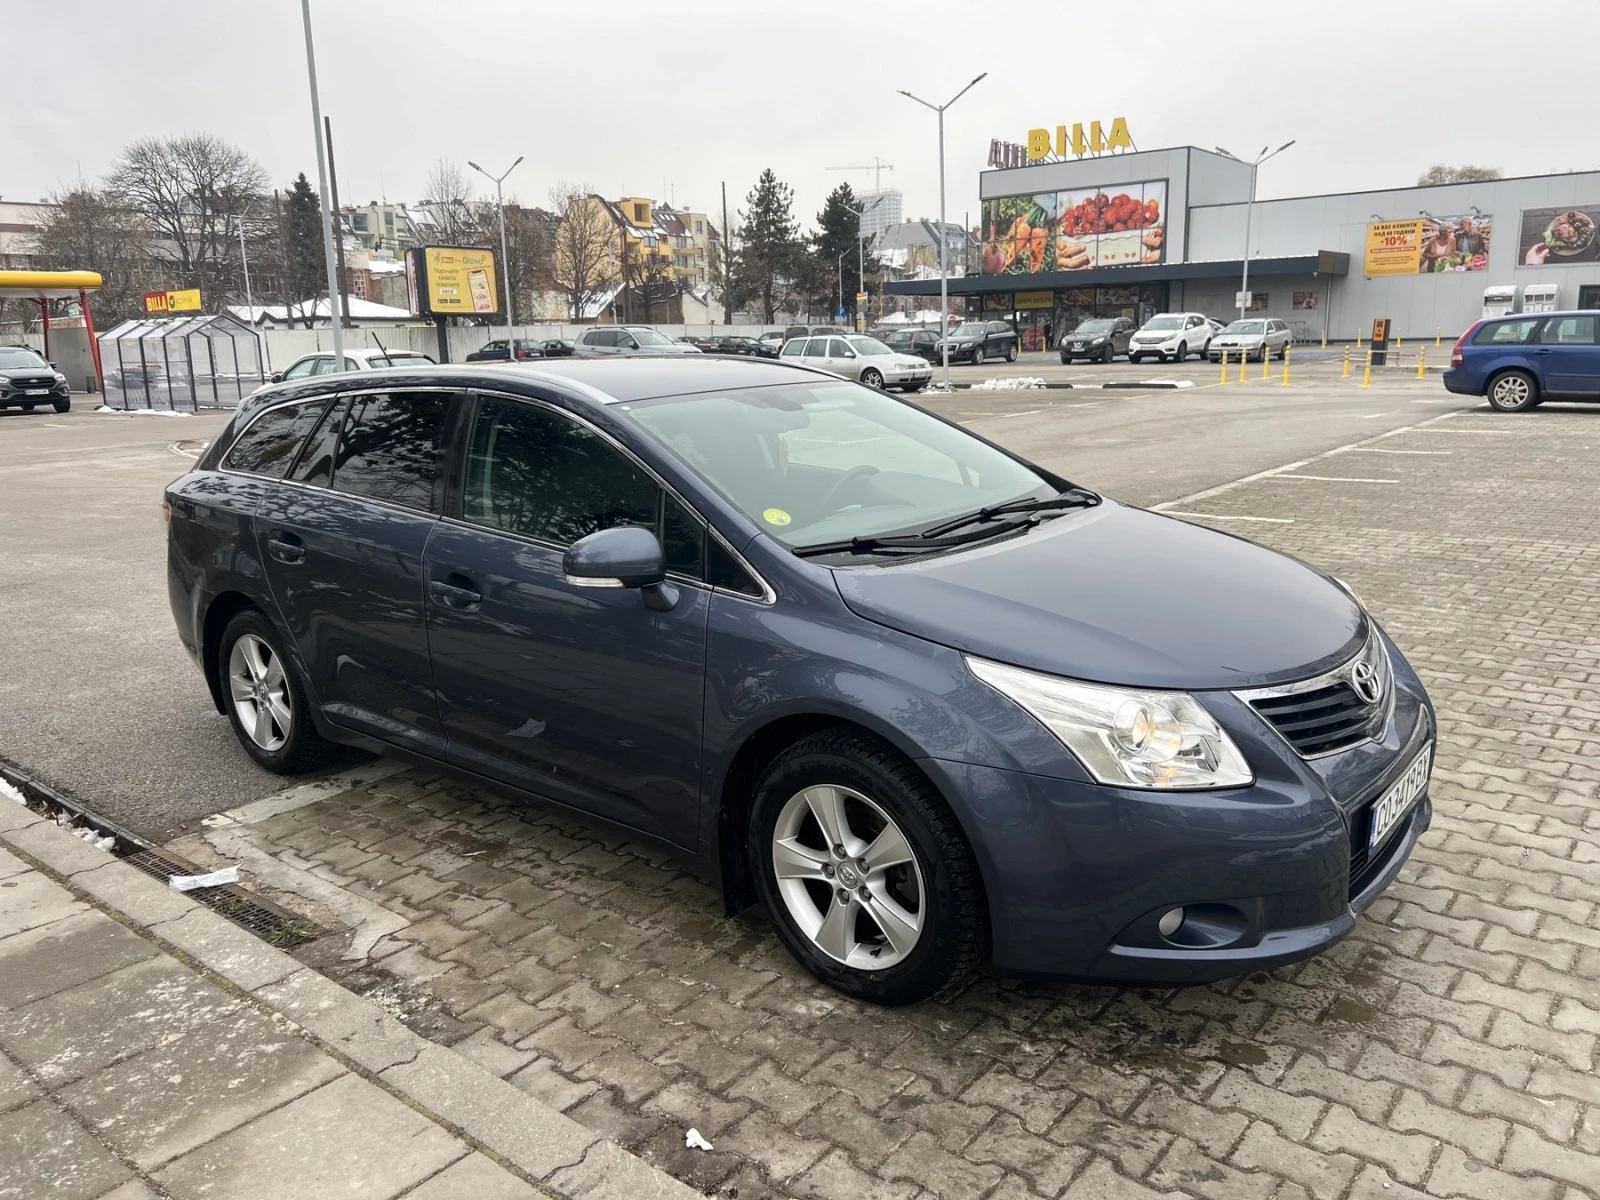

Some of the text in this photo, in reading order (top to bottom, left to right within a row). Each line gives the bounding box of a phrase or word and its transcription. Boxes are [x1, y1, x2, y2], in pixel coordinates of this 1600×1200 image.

[1028, 117, 1131, 160] BILLA
[1380, 236, 1407, 246] -10%
[462, 255, 485, 265] Glovo
[145, 295, 168, 311] BILLA
